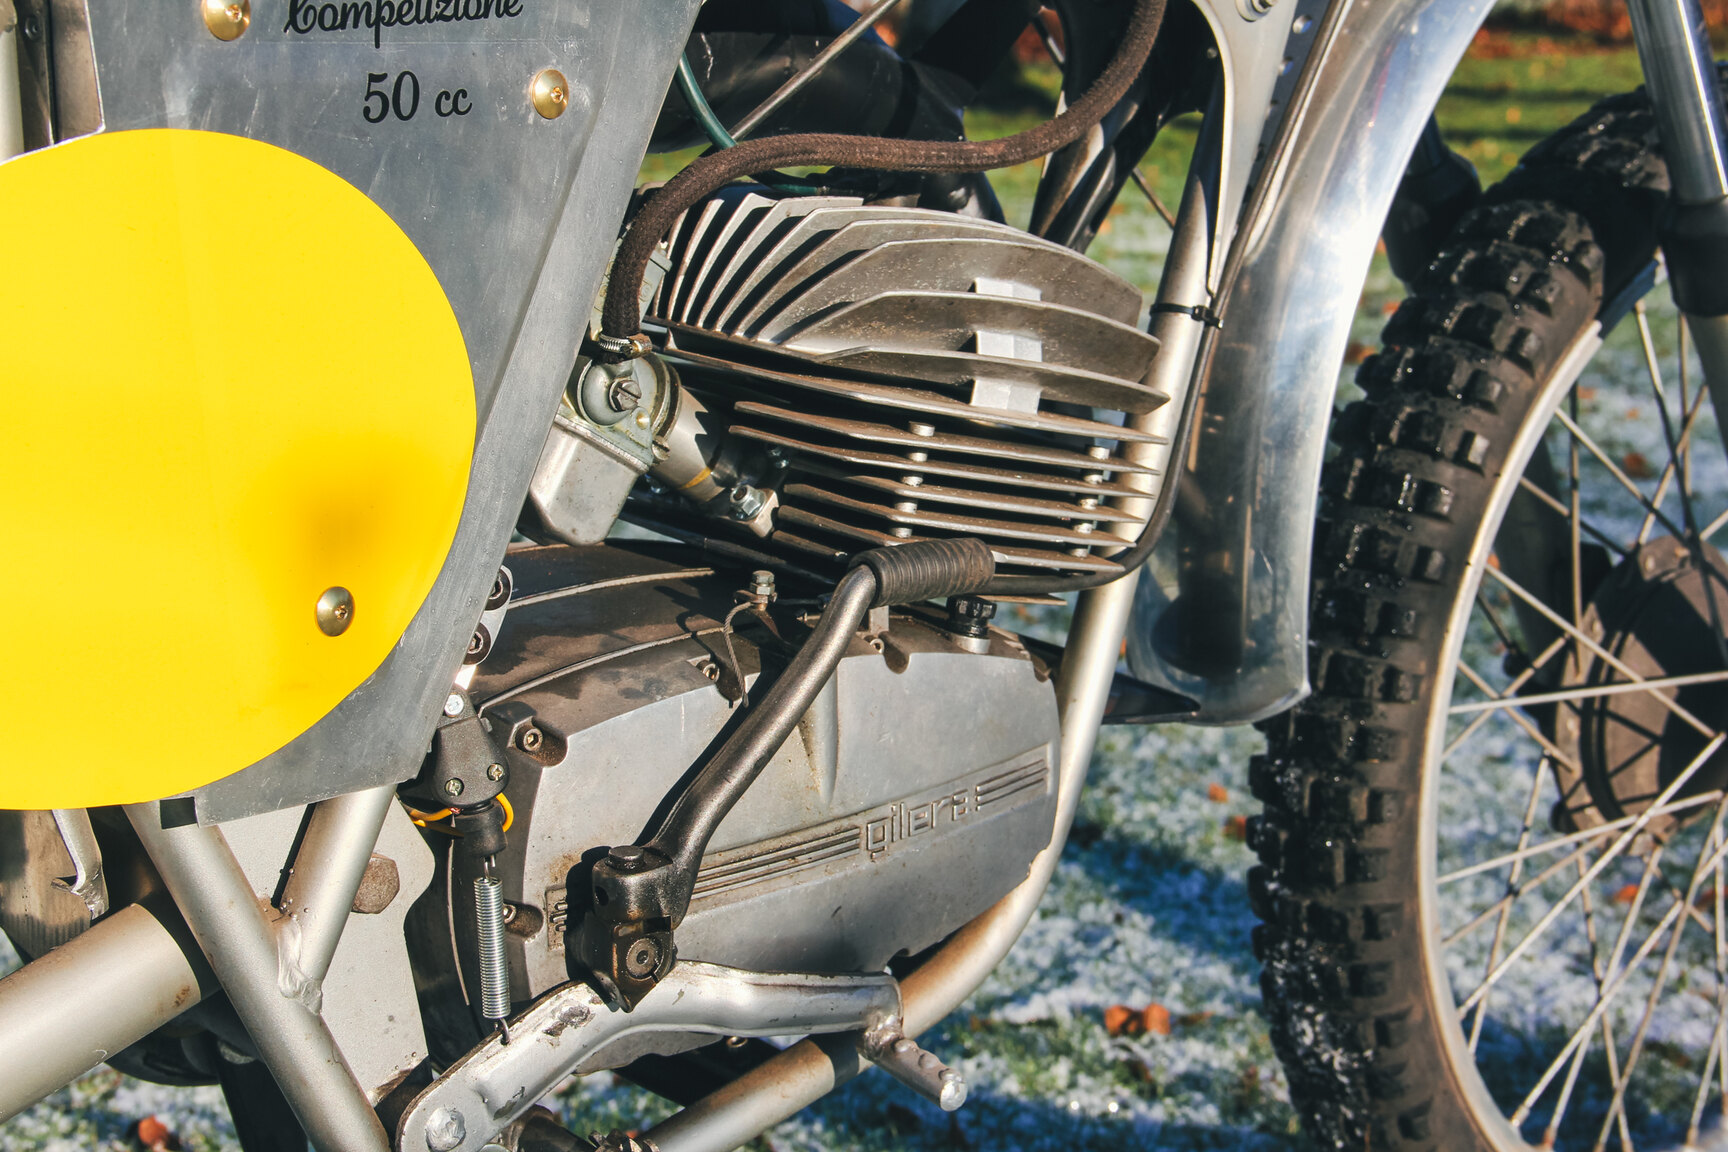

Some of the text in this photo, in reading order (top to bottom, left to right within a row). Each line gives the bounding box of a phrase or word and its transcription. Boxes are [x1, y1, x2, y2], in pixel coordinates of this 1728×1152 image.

[363, 70, 473, 123] 50 cc
[866, 788, 969, 862] gilera
